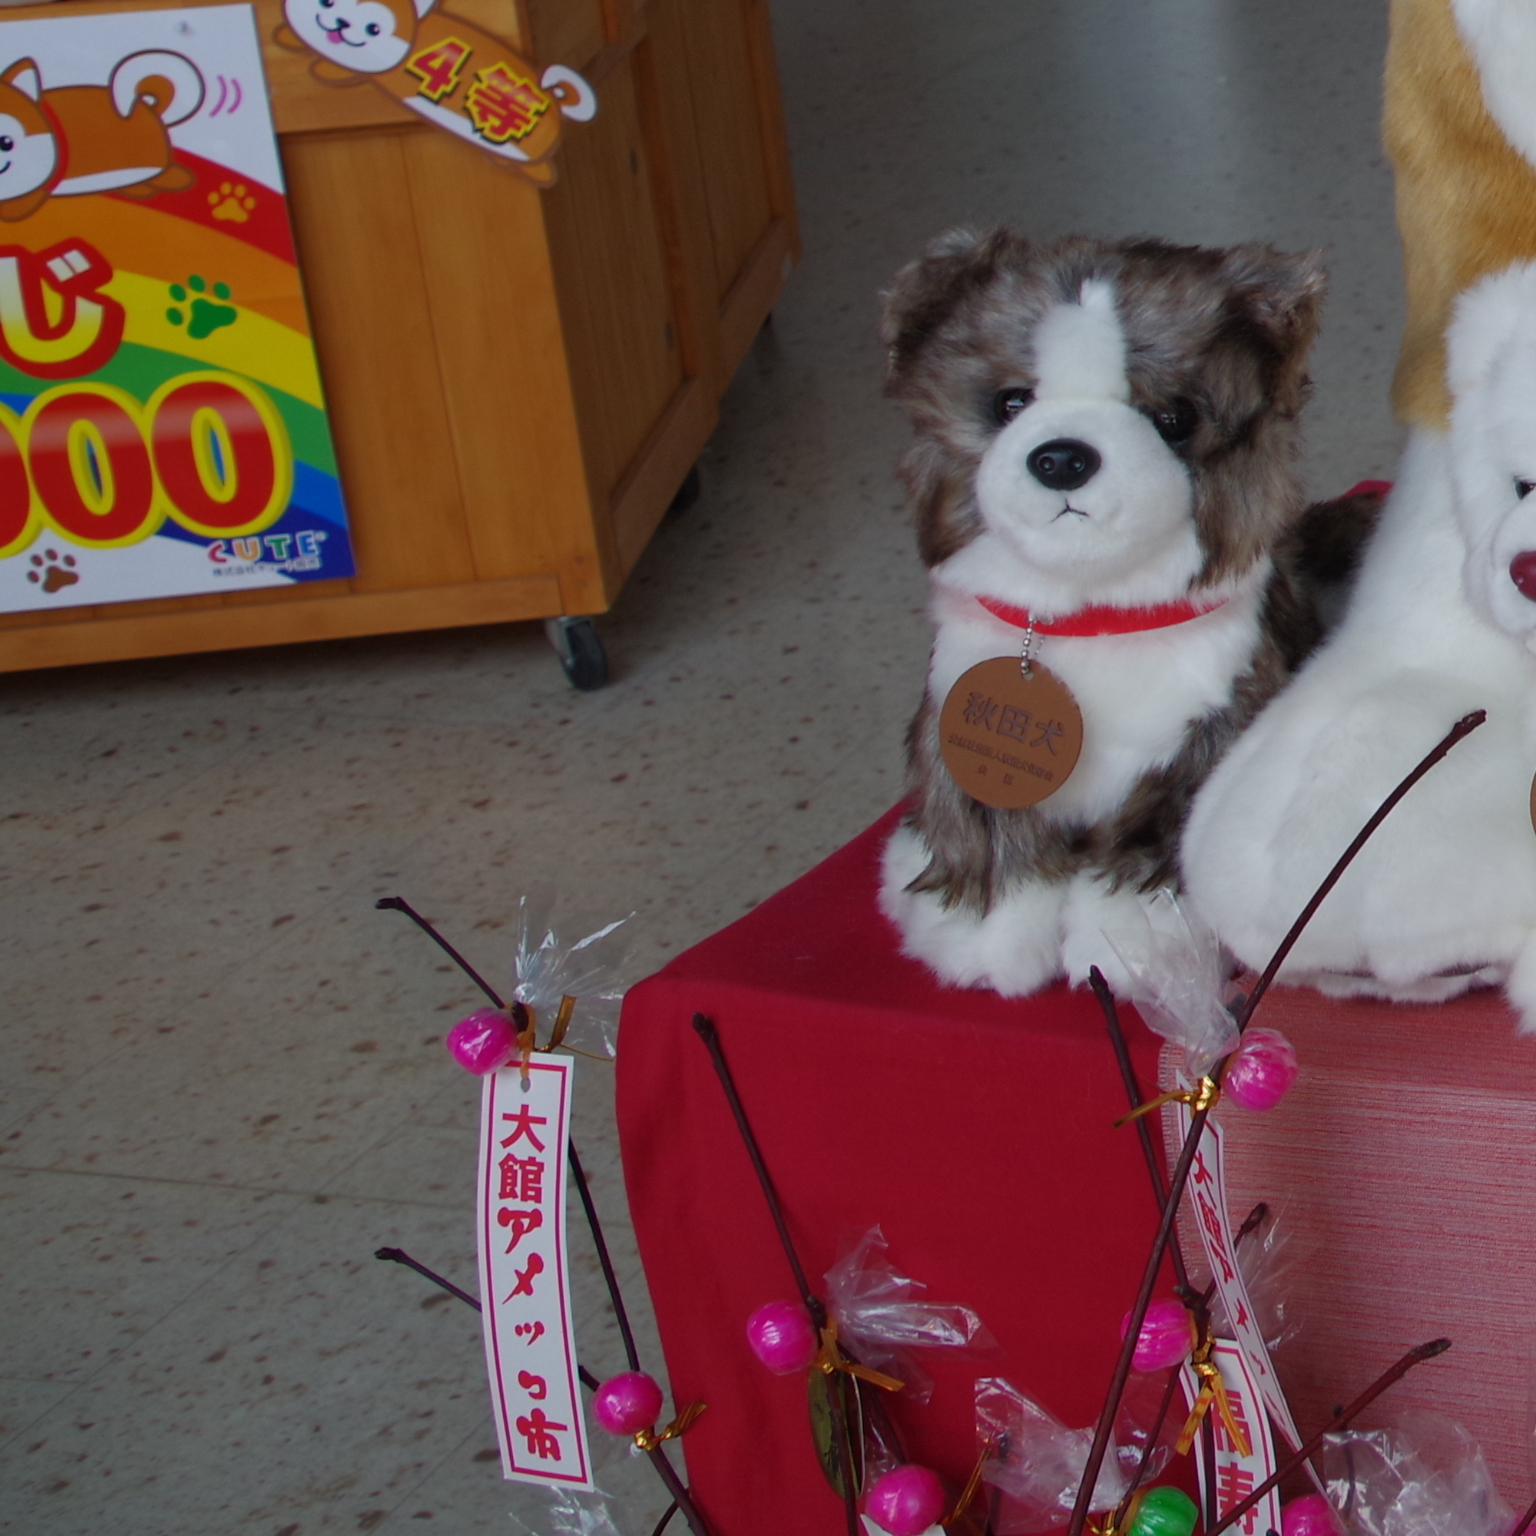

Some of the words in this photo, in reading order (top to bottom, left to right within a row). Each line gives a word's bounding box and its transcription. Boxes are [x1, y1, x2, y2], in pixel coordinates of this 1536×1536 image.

[405, 36, 551, 145] 4等
[0, 370, 295, 558] 00
[207, 529, 321, 564] CUTE
[963, 691, 1066, 757] 秋田犬
[497, 1103, 569, 1462] 大館アメッコ市
